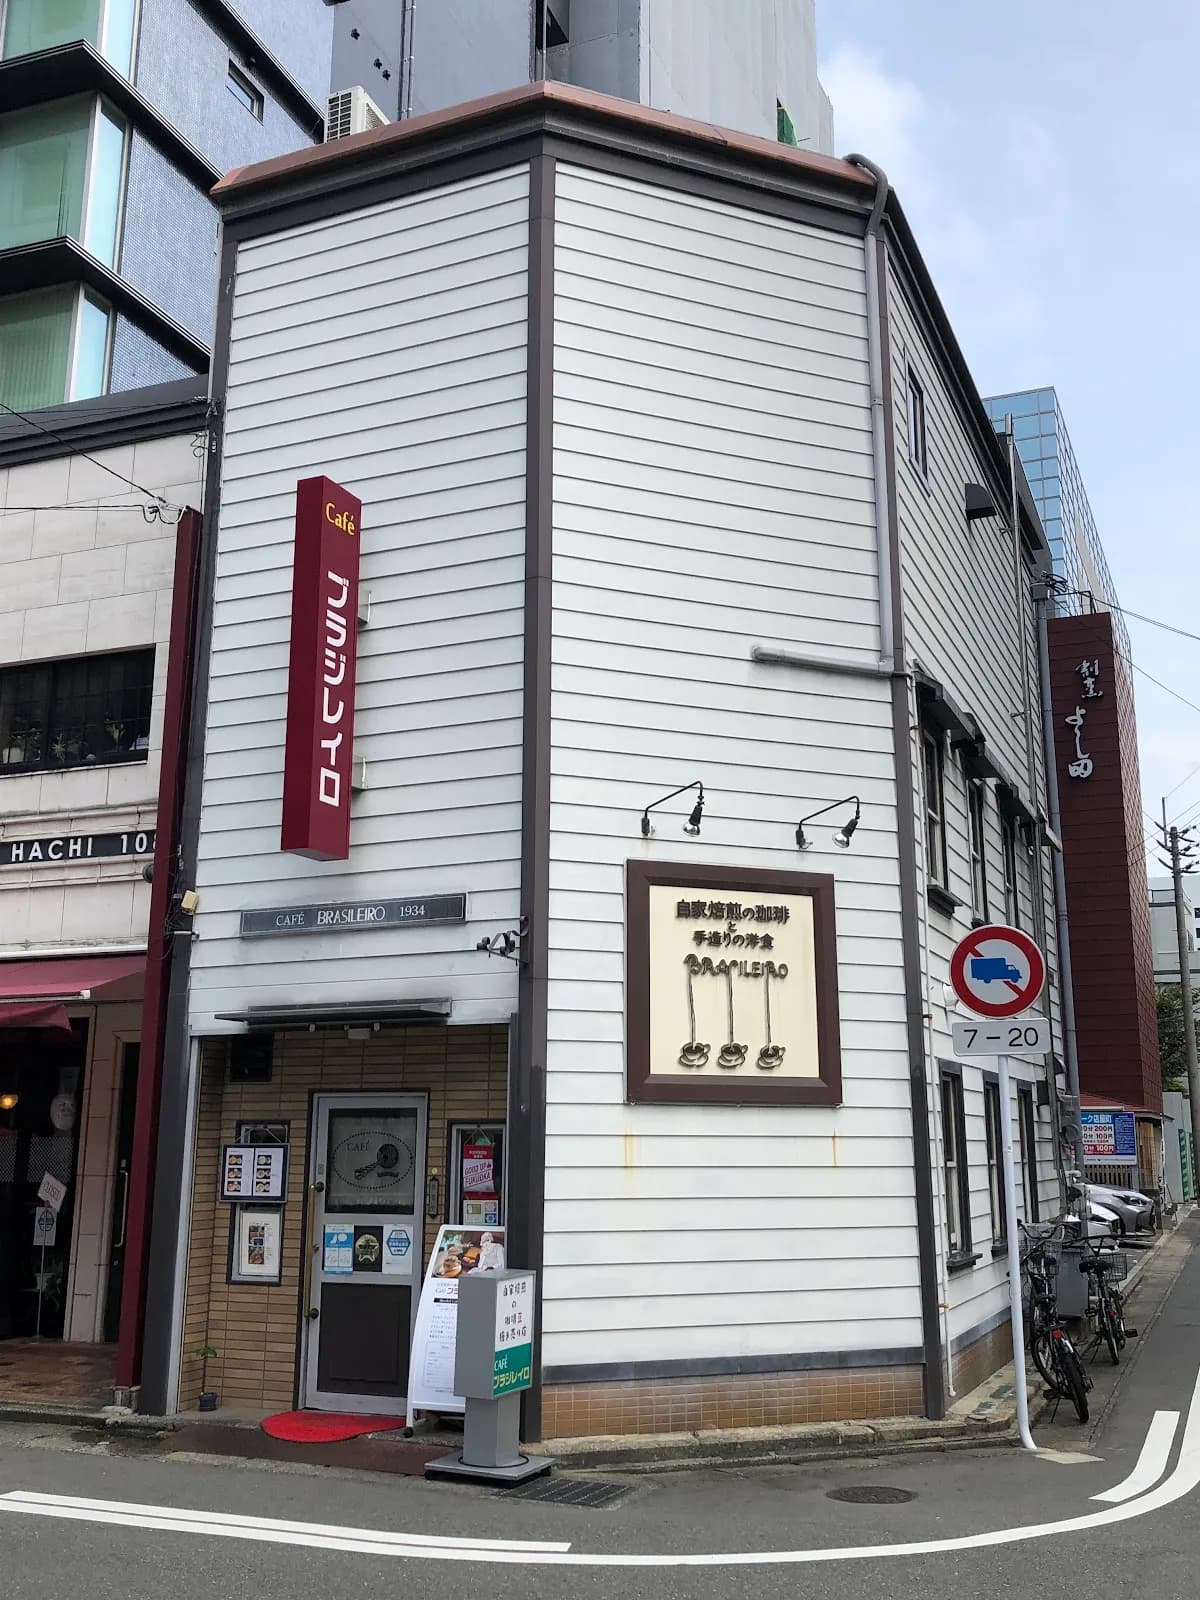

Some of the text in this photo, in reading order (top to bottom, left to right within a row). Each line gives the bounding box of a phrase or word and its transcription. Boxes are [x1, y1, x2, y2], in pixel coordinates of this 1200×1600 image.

[325, 502, 355, 536] Café
[319, 570, 350, 808] ブラジレイロ
[11, 832, 157, 862] HACHI 10
[276, 904, 426, 927] CAFÉ BRASILEIRO 1934
[676, 898, 791, 925] 自家焙煎の珈琲
[692, 930, 775, 950] 手造りの洋食
[727, 920, 738, 933] と
